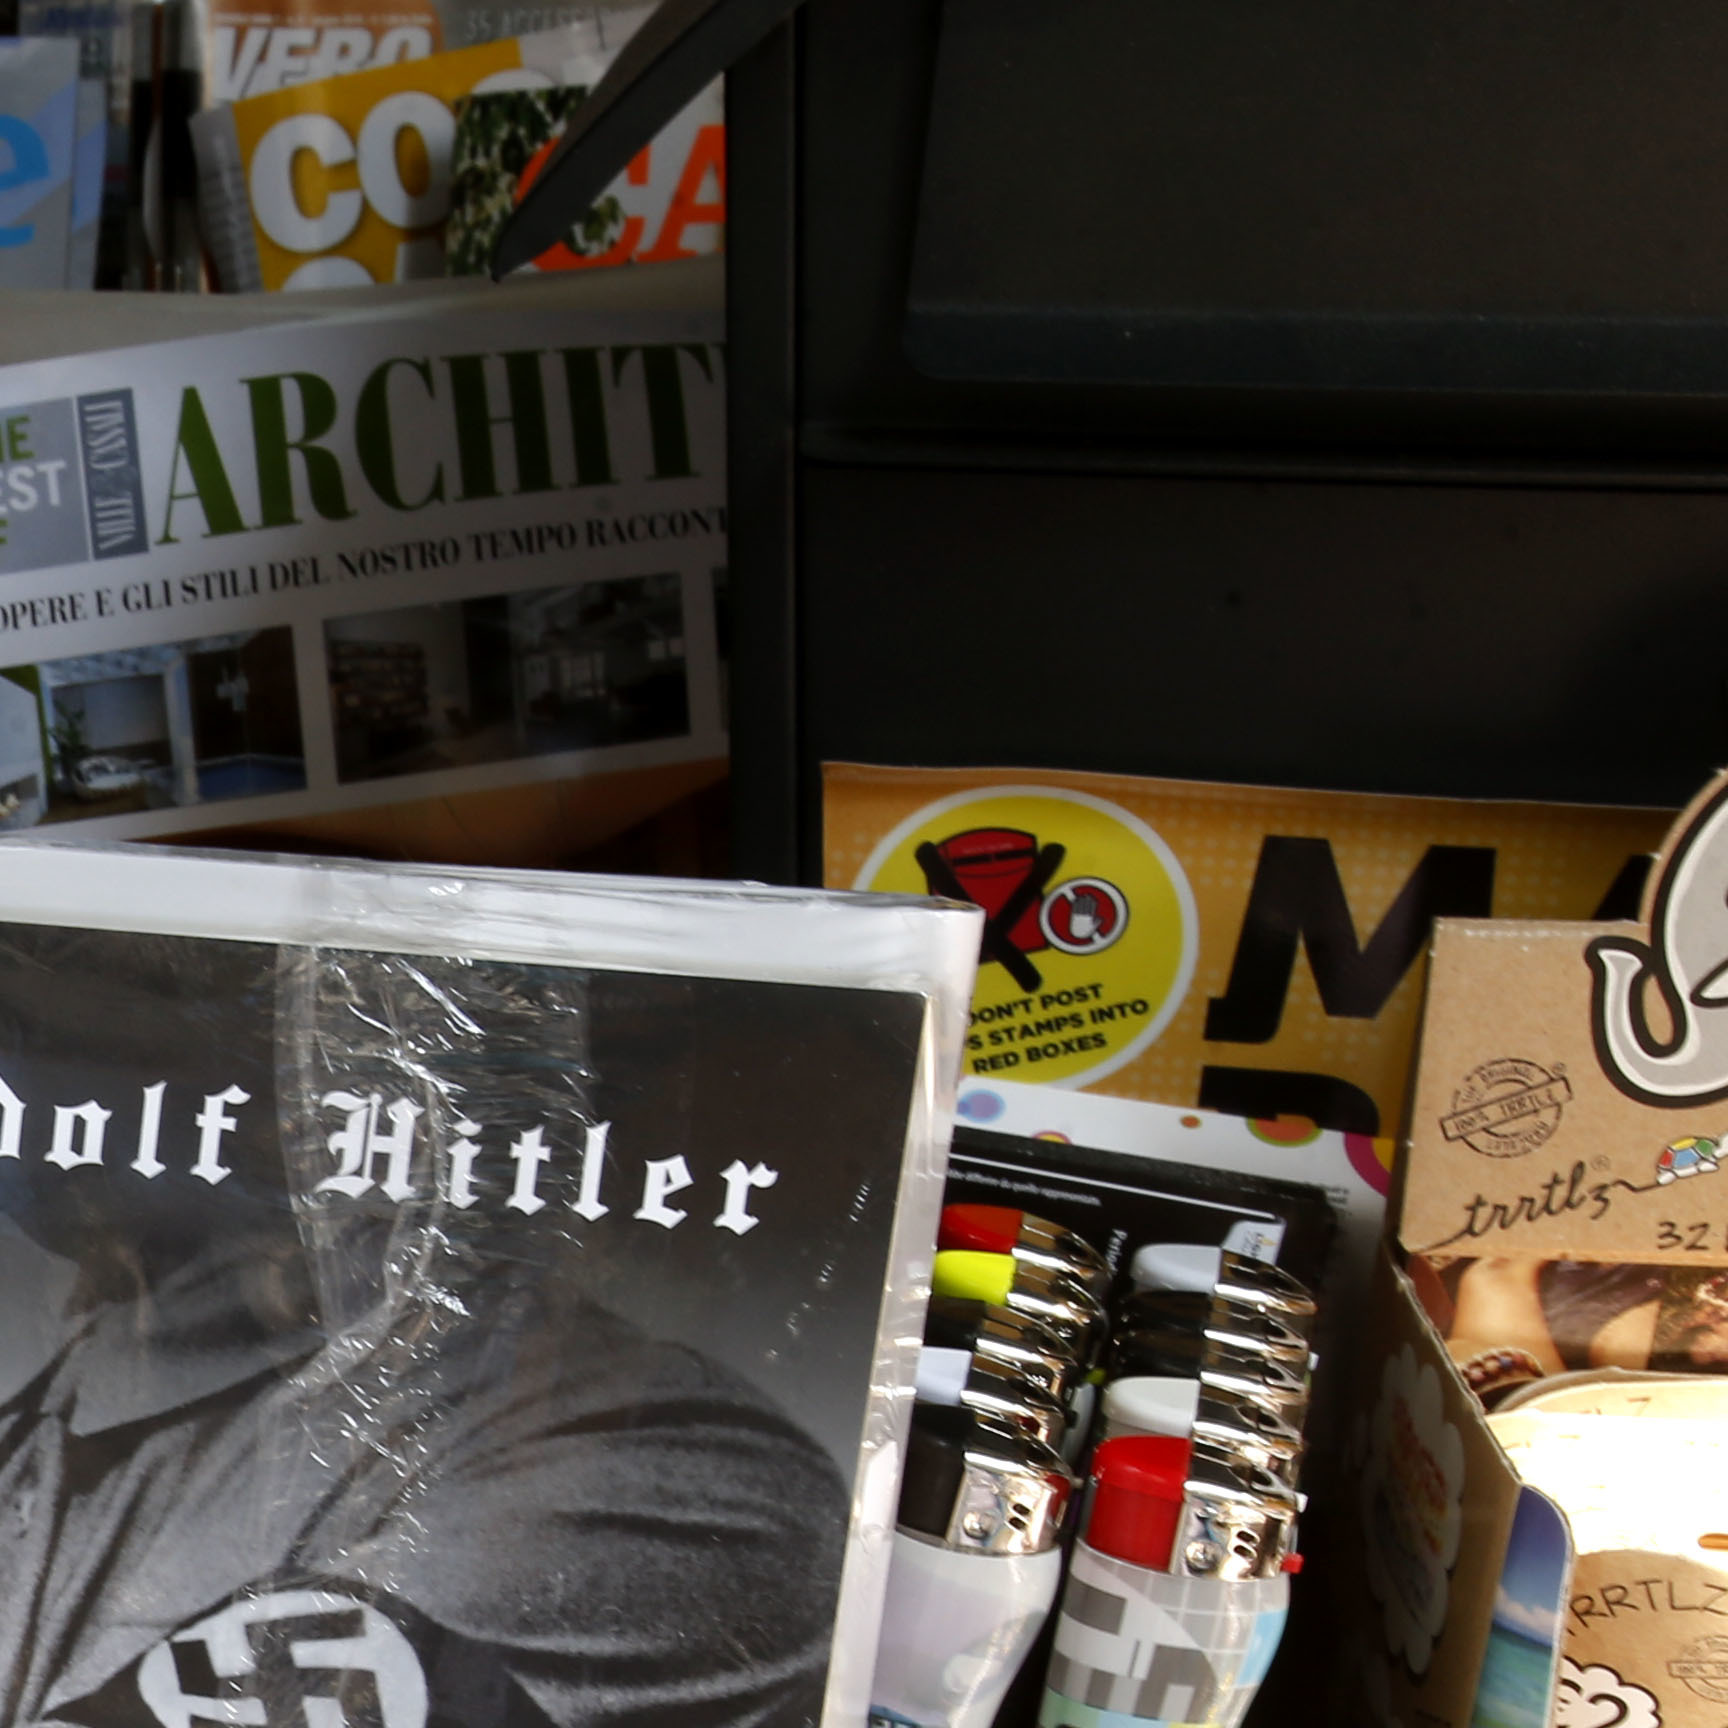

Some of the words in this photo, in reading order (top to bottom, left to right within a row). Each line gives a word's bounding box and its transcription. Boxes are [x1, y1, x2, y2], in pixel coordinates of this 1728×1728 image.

[95, 588, 114, 618] E
[122, 581, 173, 615] GLI
[179, 567, 260, 608] STILI
[269, 558, 330, 597] DEL
[337, 537, 461, 583] NOSTRO
[466, 522, 578, 563] TEMPO
[970, 999, 1033, 1028] DON'T
[1039, 982, 1104, 1012] POST
[989, 1013, 1085, 1049] STAMPS
[1090, 998, 1151, 1025] INTO
[972, 1050, 1021, 1075] RED
[1027, 1032, 1108, 1064] BOXES
[316, 1088, 780, 1235] Hitler
[1566, 1579, 1728, 1637] RRTLZ
